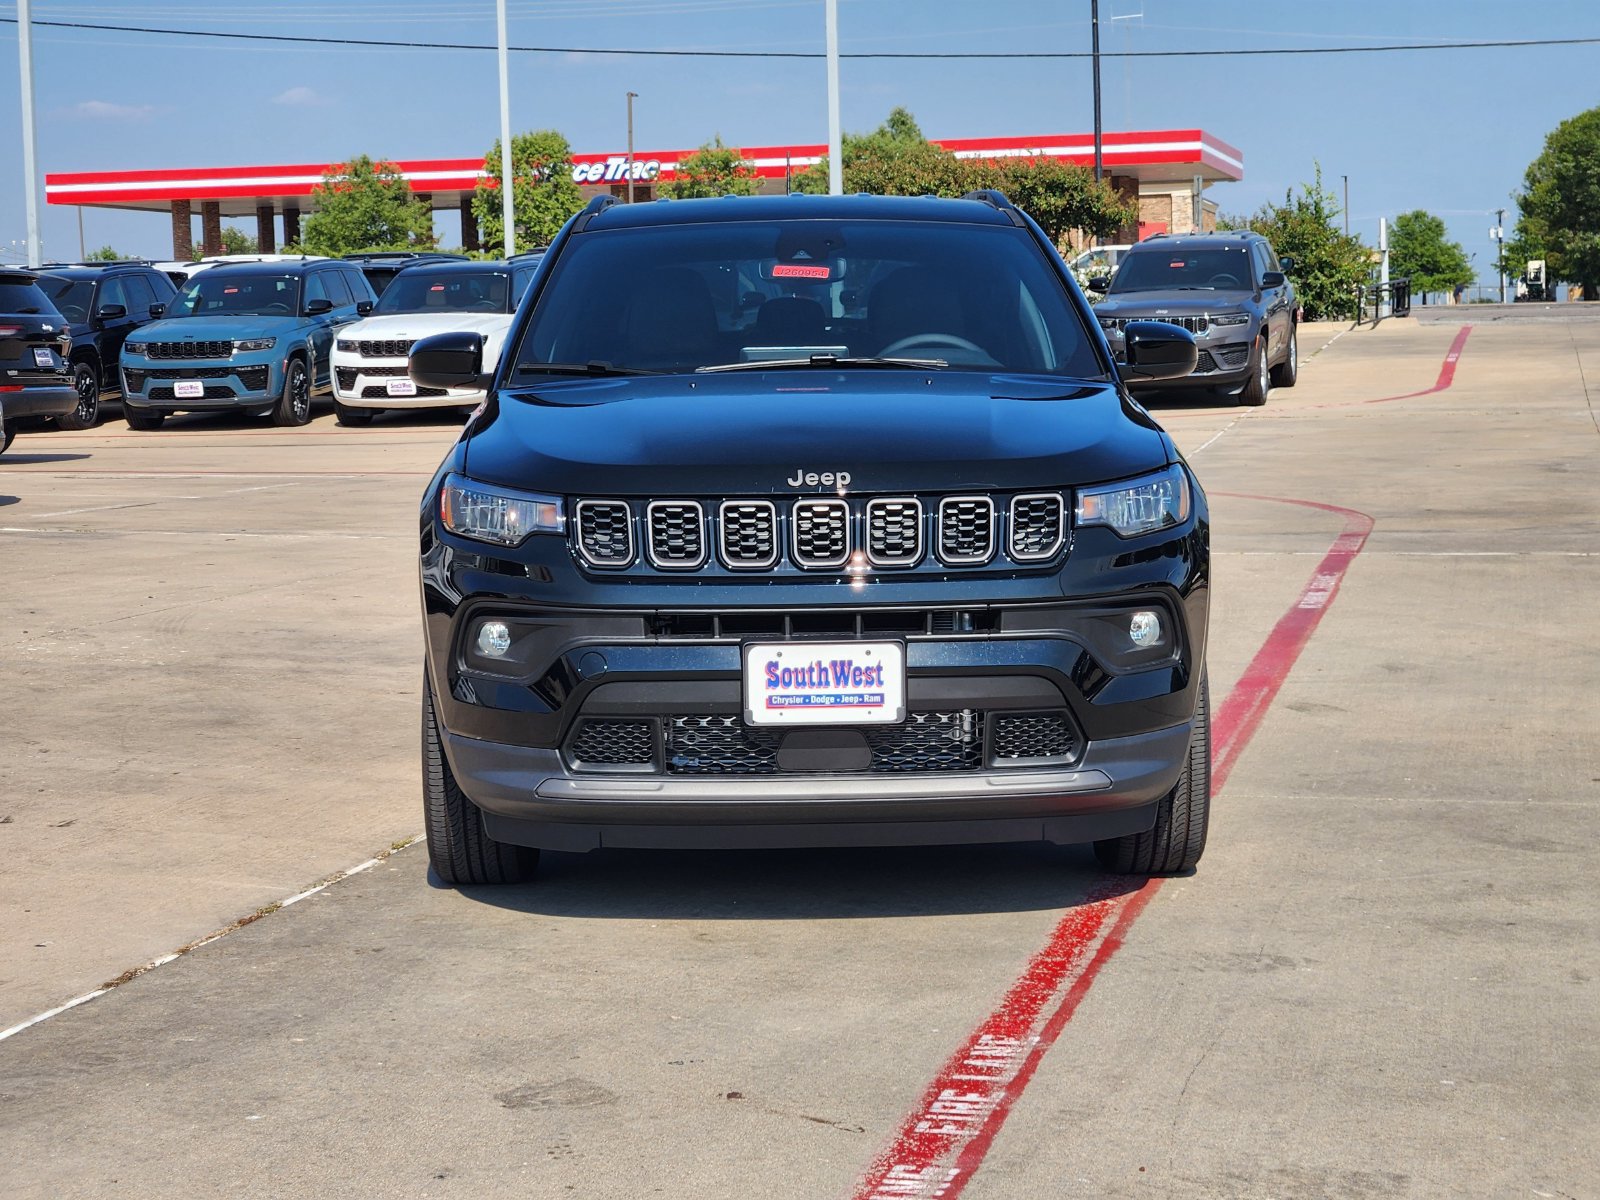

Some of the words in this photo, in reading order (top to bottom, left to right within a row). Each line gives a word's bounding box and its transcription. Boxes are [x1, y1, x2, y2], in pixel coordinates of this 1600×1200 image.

[564, 156, 661, 182] ceTrac
[787, 469, 851, 489] Jeep
[765, 659, 884, 690] SouthWest
[772, 695, 804, 706] Chrysler
[810, 695, 835, 706] Dodge
[841, 694, 859, 705] Jeep
[863, 694, 881, 703] Ram
[914, 1089, 1006, 1135] FIRE
